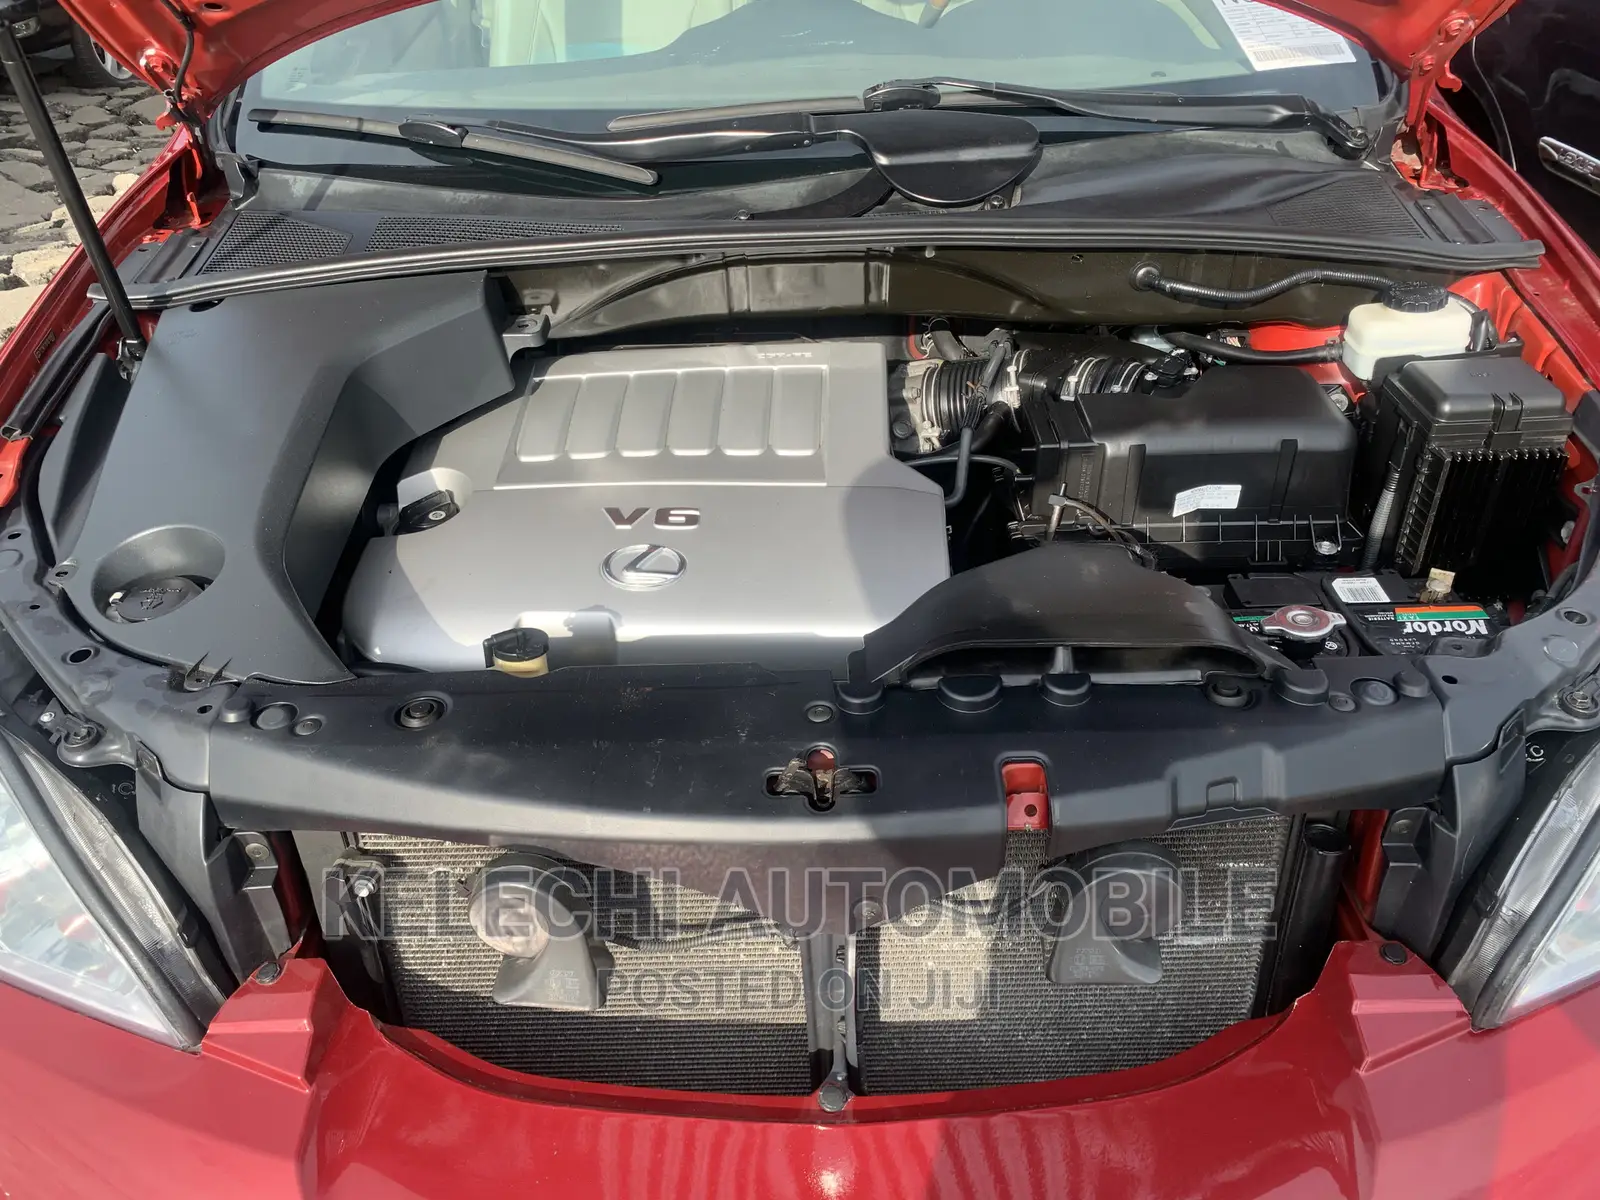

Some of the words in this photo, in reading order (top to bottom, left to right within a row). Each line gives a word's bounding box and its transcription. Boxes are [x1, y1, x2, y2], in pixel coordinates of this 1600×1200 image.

[1558, 148, 1596, 172] LEXUS
[602, 507, 701, 530] V6
[1402, 620, 1488, 636] Nordor
